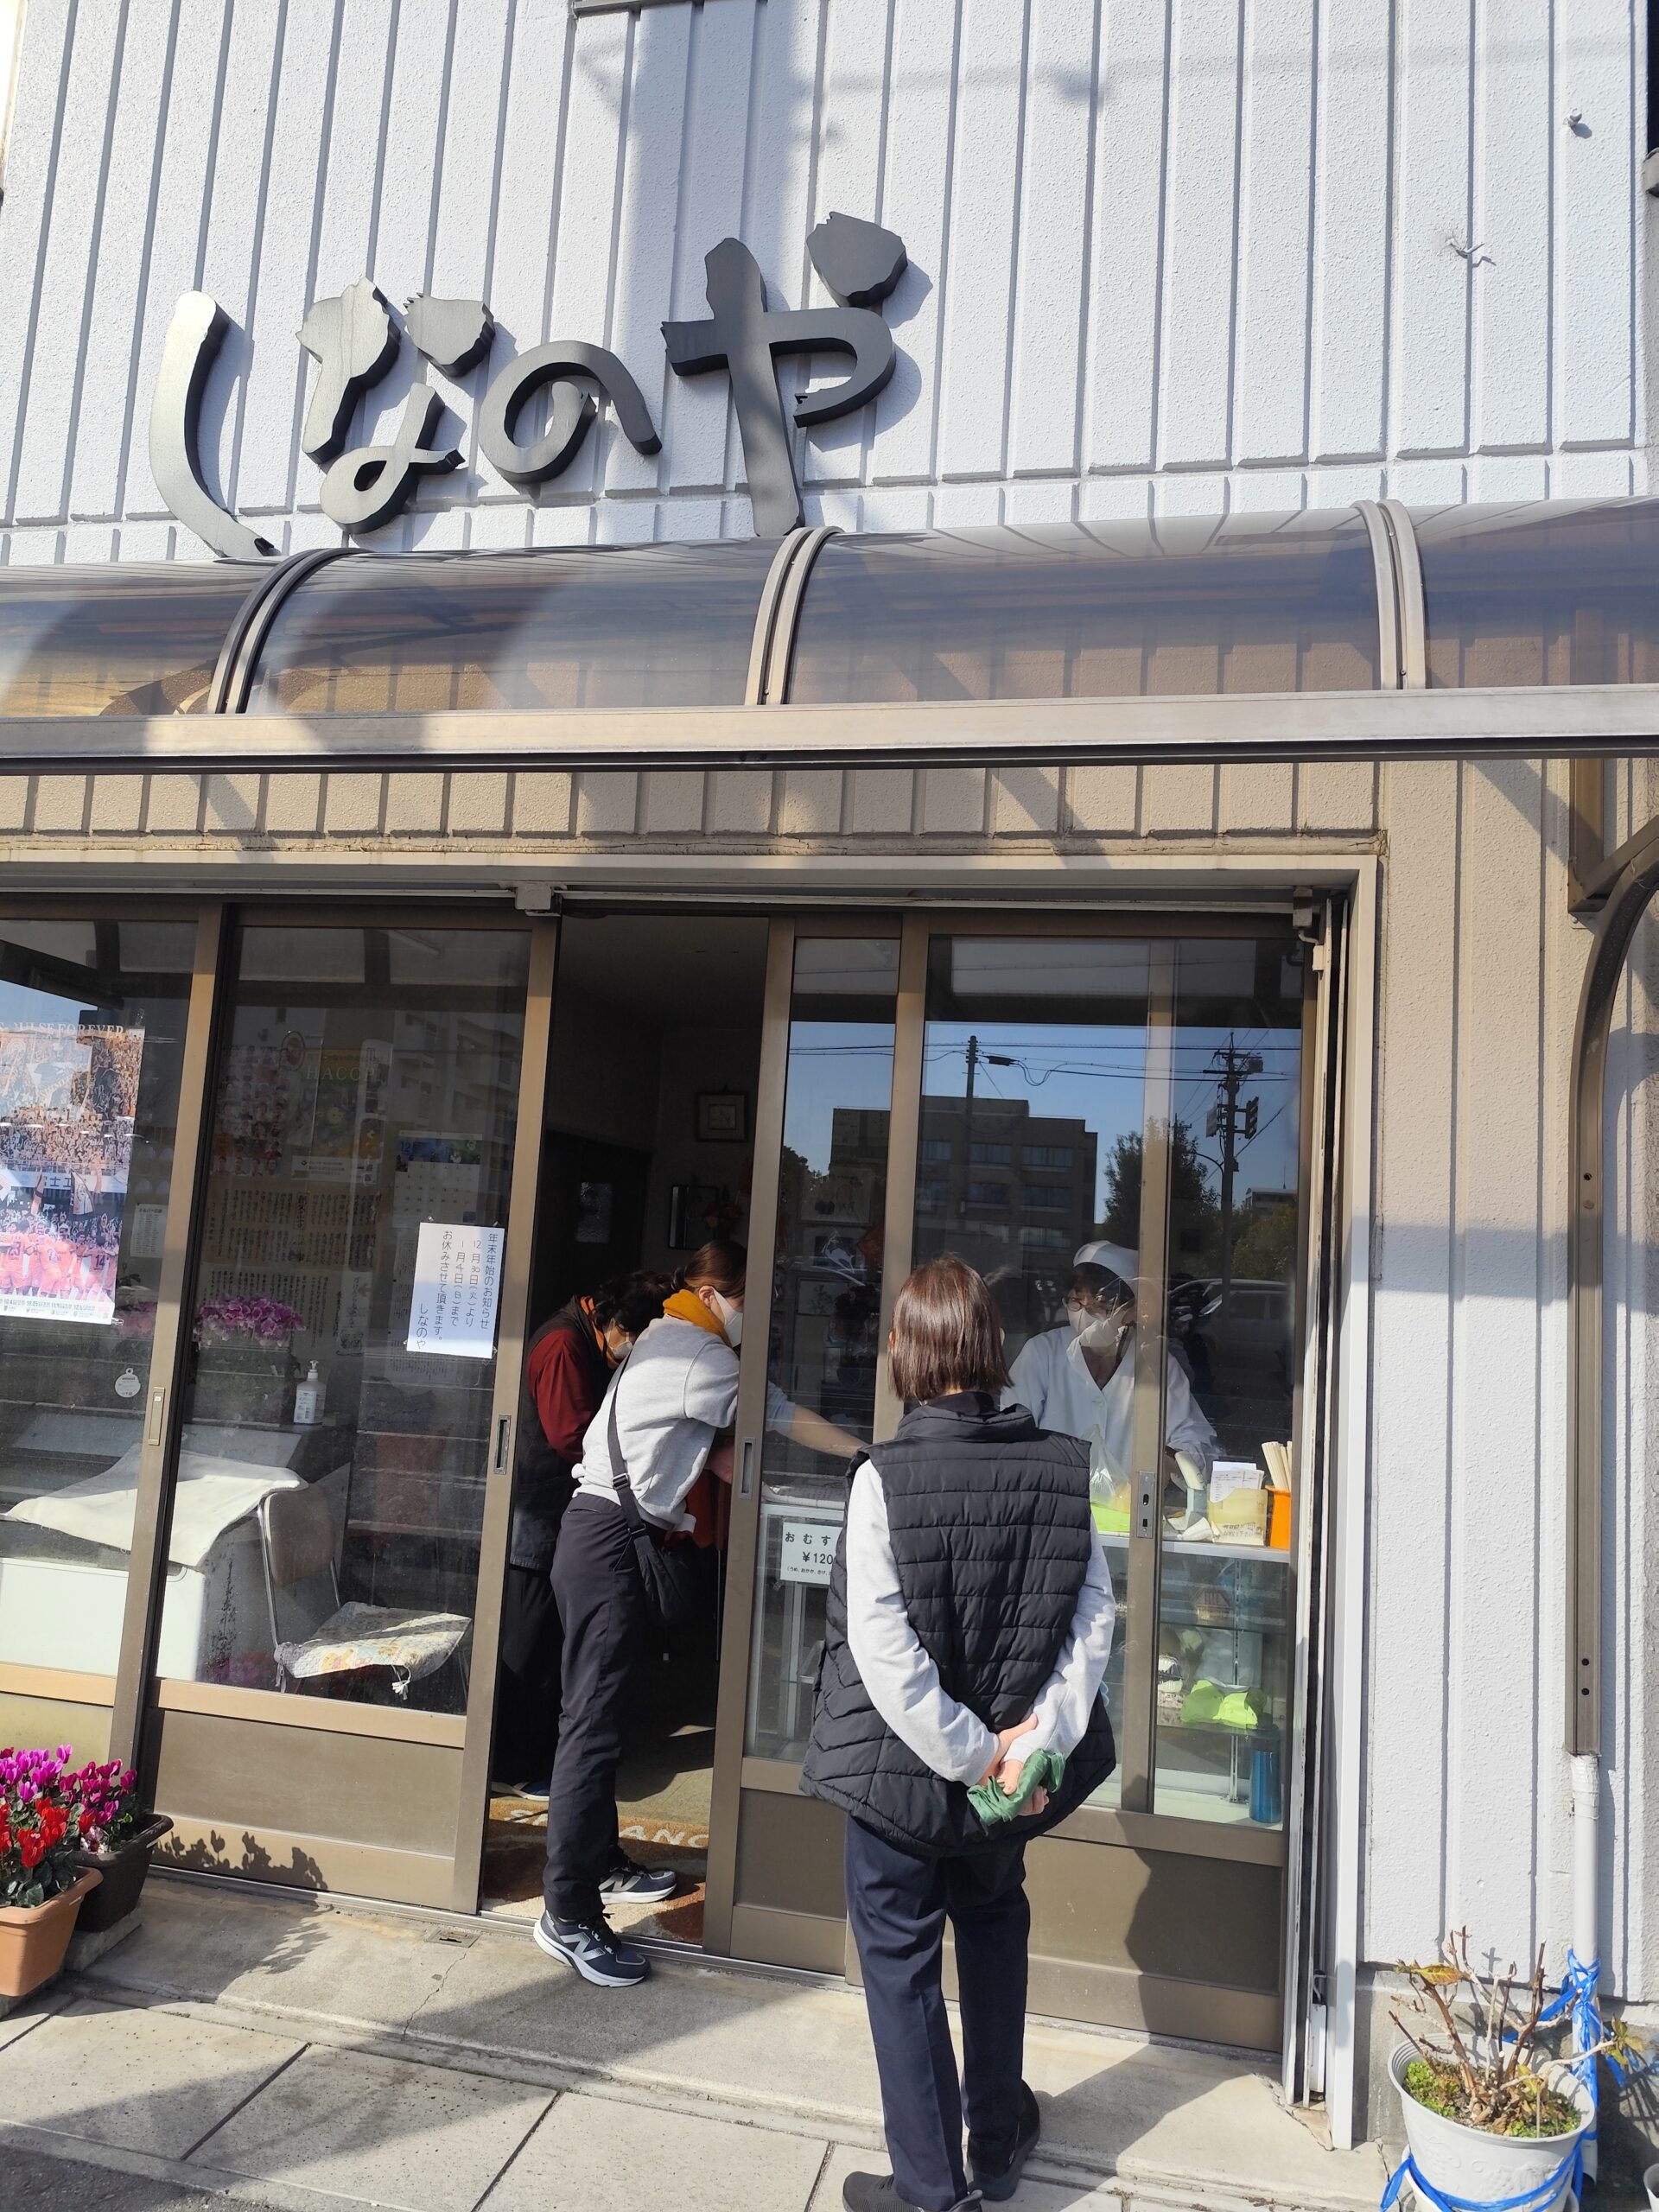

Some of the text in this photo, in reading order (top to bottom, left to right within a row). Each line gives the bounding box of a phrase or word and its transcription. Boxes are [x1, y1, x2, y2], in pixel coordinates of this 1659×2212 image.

[149, 211, 910, 560] しなのや
[416, 1303, 429, 1350] しなのや
[434, 1230, 453, 1341] お休みさせて頂きます。
[480, 1233, 499, 1330] 年末年始のお知らせ
